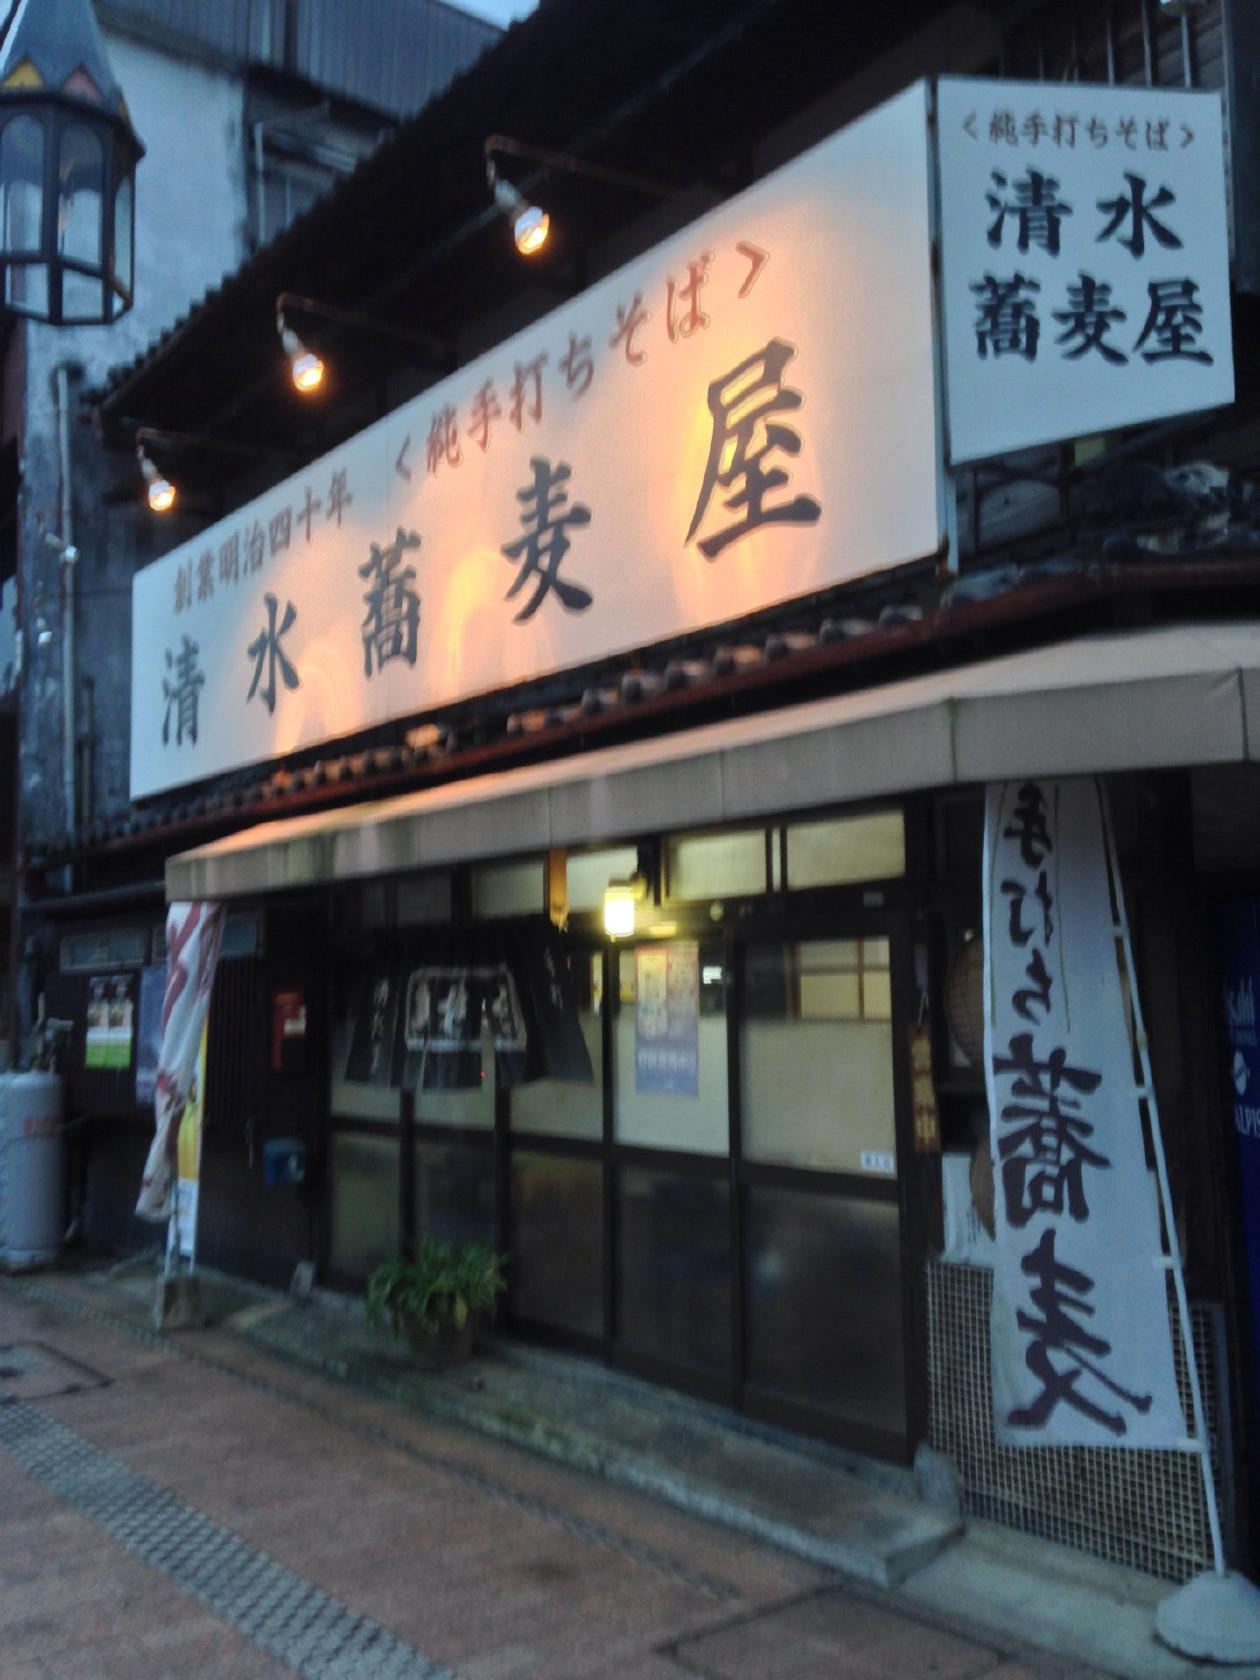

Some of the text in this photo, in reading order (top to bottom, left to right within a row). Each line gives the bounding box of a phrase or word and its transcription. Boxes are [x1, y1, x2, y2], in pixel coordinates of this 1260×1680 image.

[984, 164, 1184, 259] 清水
[969, 270, 1214, 367] 蕎麦屋
